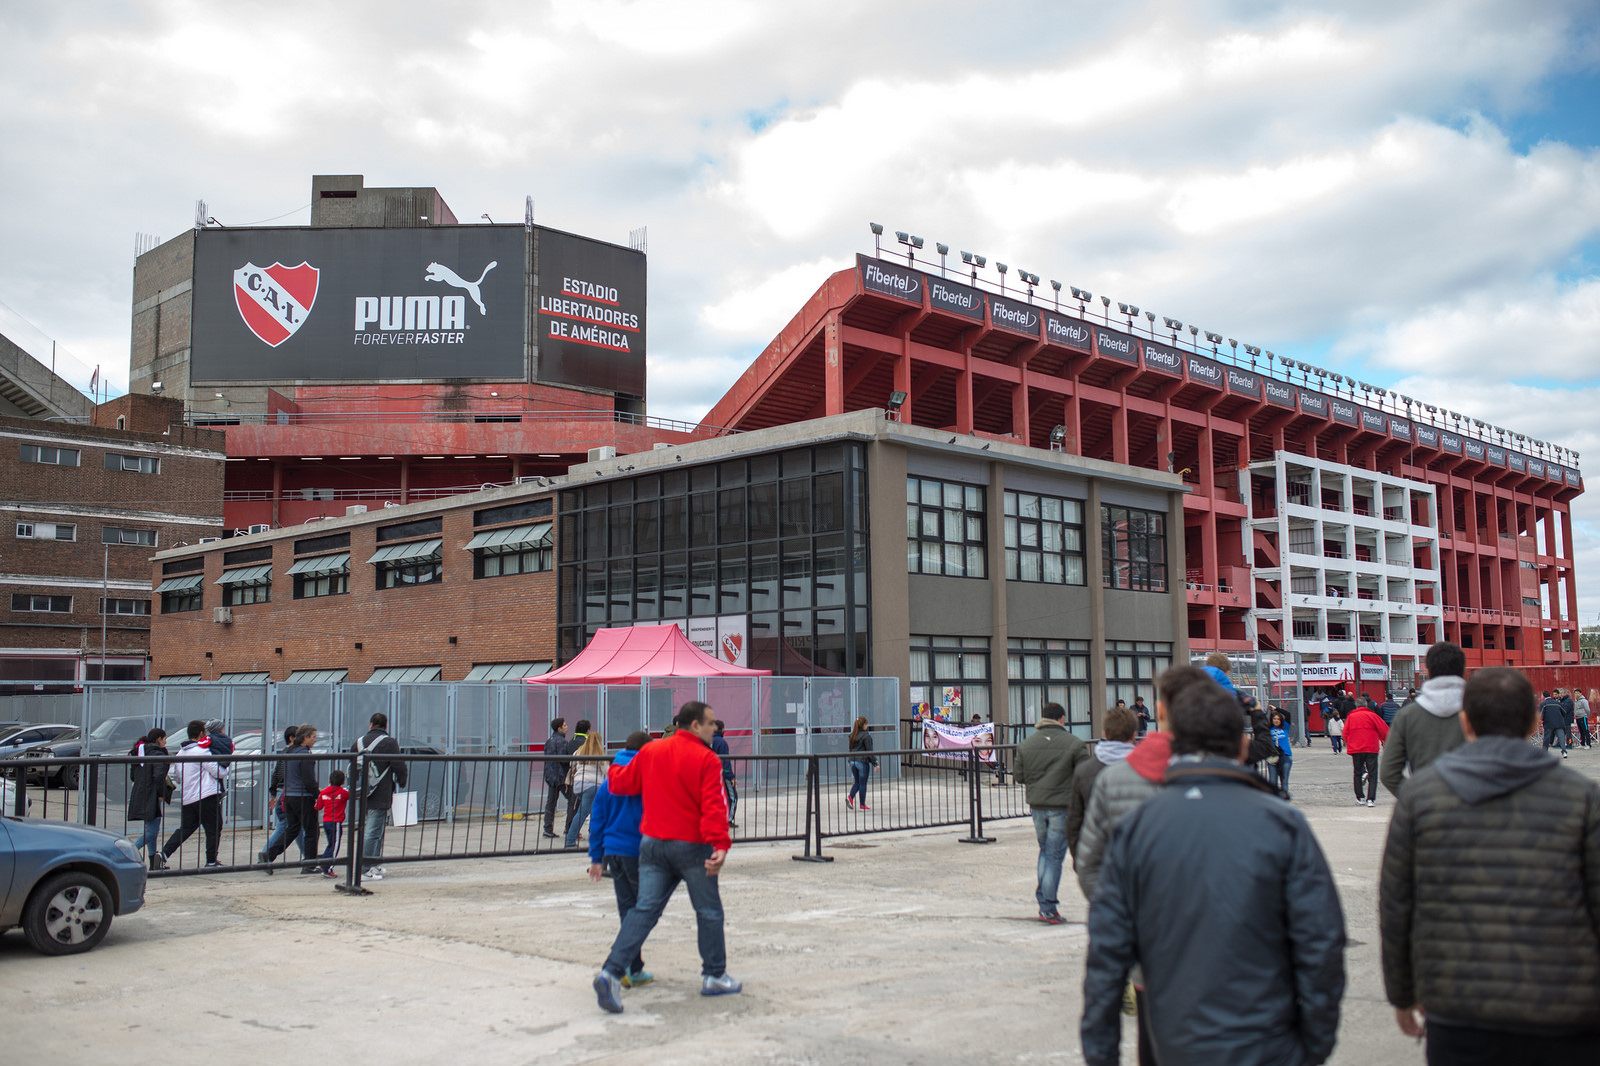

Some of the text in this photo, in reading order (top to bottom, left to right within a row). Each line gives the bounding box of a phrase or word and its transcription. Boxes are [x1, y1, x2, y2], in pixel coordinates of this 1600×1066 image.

[866, 264, 909, 290] Fibertel
[563, 277, 618, 302] ESTADIO
[932, 284, 972, 308] Fibertel
[354, 295, 466, 331] PUMA
[541, 295, 638, 329] LIBERTADORES
[993, 302, 1029, 324] Fibertel
[550, 320, 629, 349] DE AMÉRICA
[1048, 318, 1081, 339] Fibertel
[1098, 333, 1129, 353] Fibertel
[1145, 346, 1175, 366] Fibertel
[1190, 359, 1216, 378] Fibertel
[1229, 371, 1253, 389] Fibertel
[1266, 382, 1289, 399] Fibertel
[1300, 392, 1322, 409] Fibertel
[1332, 402, 1353, 418] Fibertel
[1363, 411, 1382, 426] Fibertel
